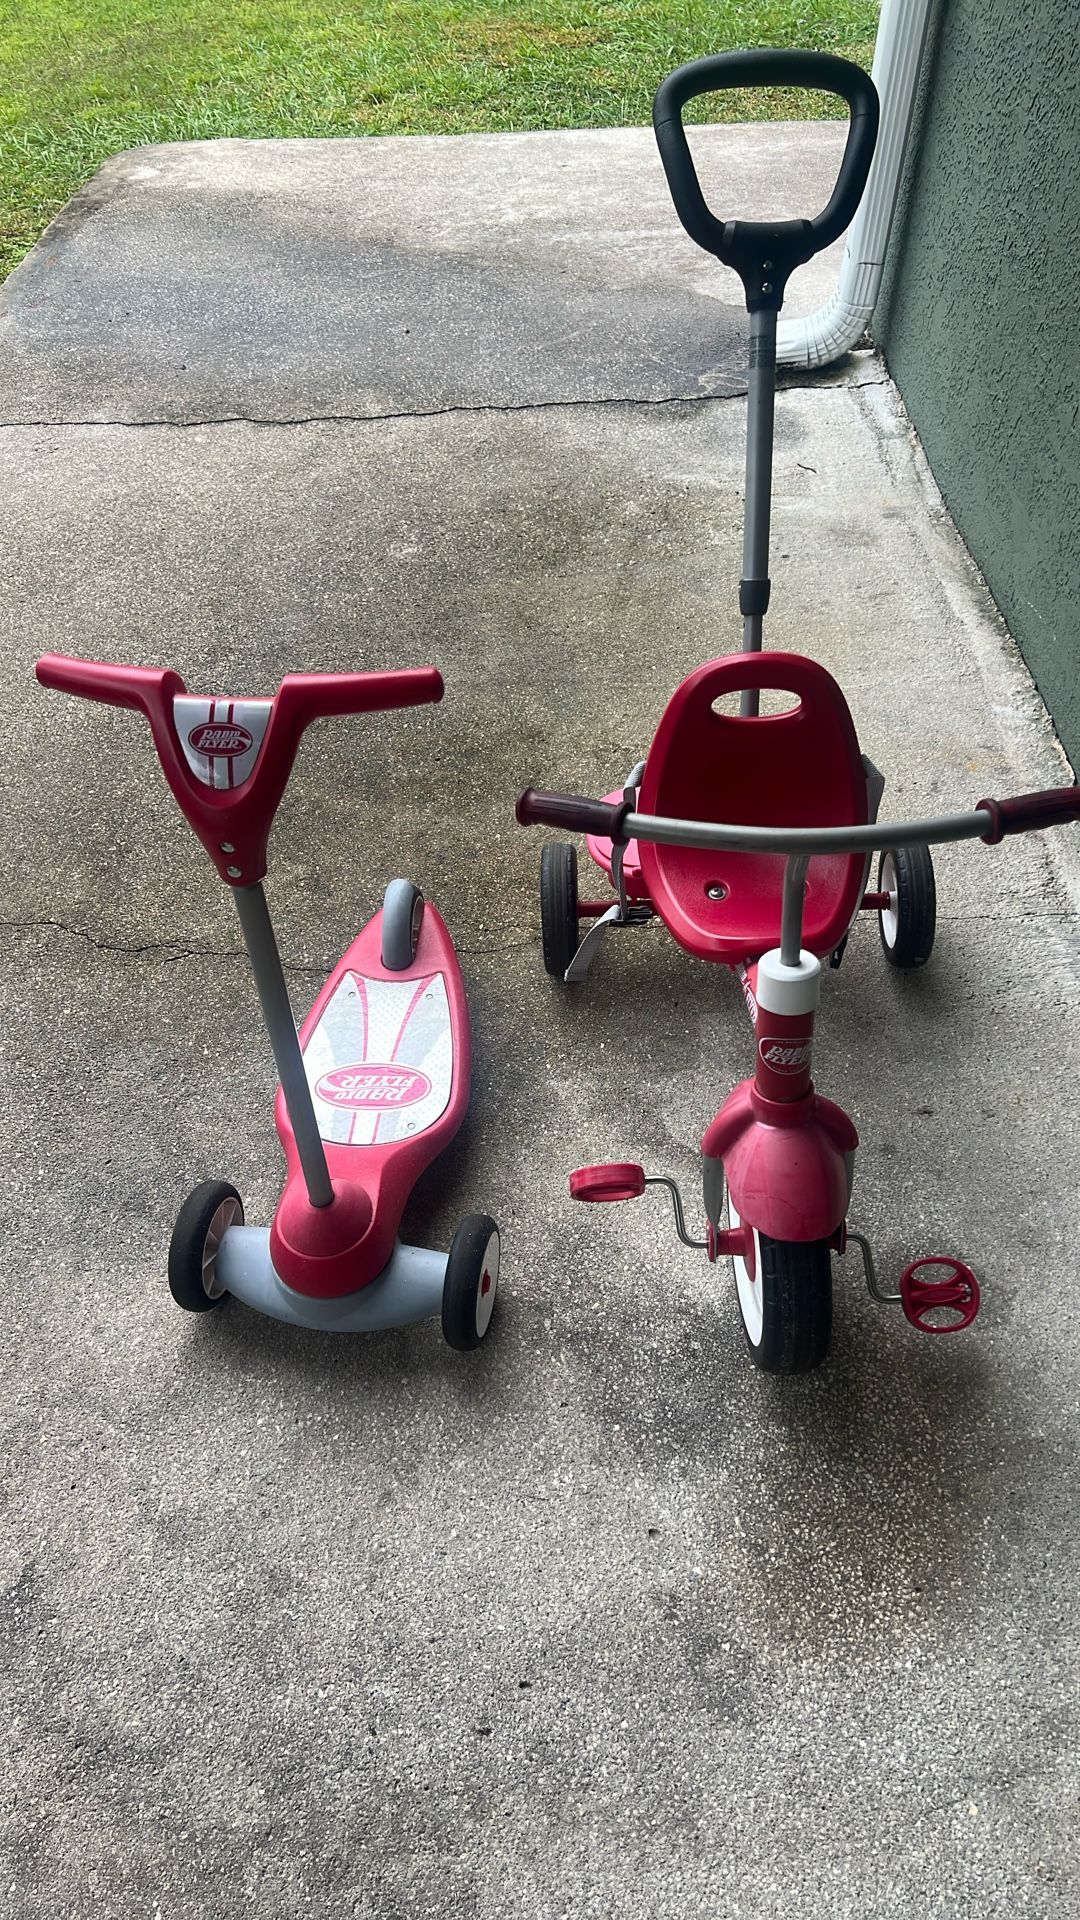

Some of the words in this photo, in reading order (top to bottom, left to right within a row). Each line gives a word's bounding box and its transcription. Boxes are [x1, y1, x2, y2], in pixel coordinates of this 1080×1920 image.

[201, 729, 241, 740] RADIO
[197, 740, 241, 749] FLYER
[338, 1075, 419, 1088] FLYER
[334, 1086, 409, 1101] RADIO
